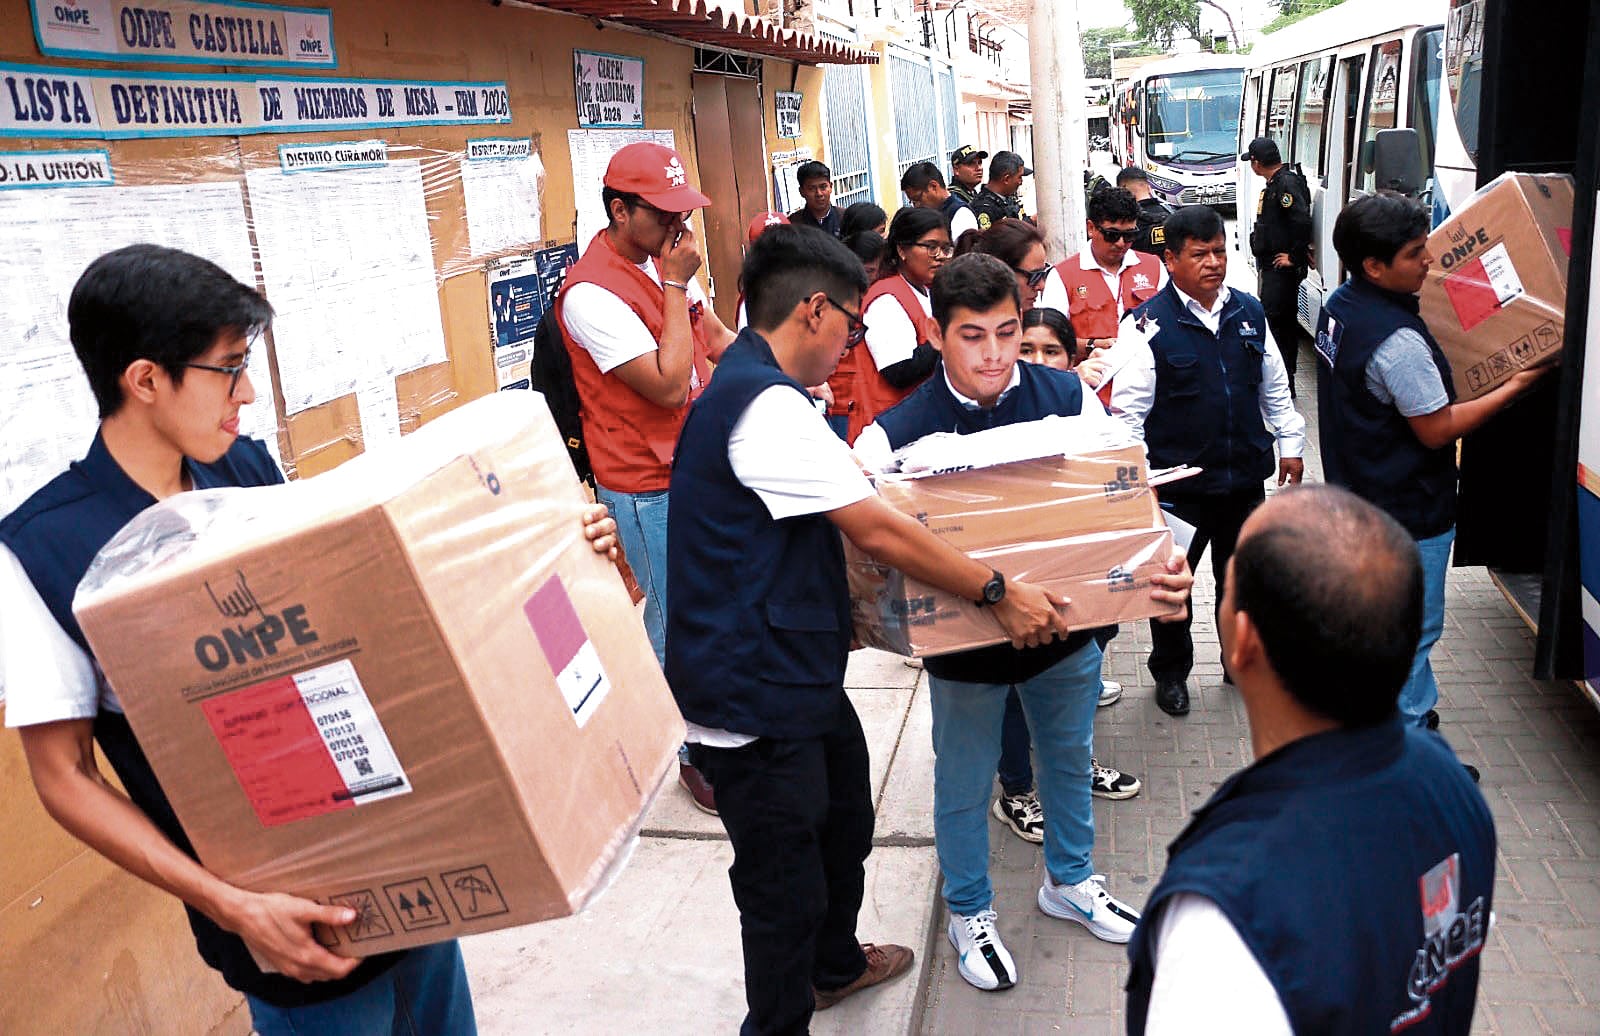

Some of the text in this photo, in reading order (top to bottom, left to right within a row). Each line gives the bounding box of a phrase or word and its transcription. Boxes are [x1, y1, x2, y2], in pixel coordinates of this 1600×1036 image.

[55, 6, 90, 24] ONPE
[120, 6, 284, 55] ODPE CASTILLA
[300, 39, 323, 53] ONPE
[5, 76, 92, 124] LISTA
[110, 84, 242, 124] DEFINITIVA
[259, 87, 283, 121] DE
[293, 87, 368, 120] MIEMBROS
[376, 87, 395, 117] DE
[403, 87, 439, 116] MESA
[455, 90, 478, 116] ERM
[482, 89, 508, 117] 2026
[15, 163, 39, 181] LA
[1440, 227, 1489, 269] ONPE
[194, 603, 319, 673] ONPE
